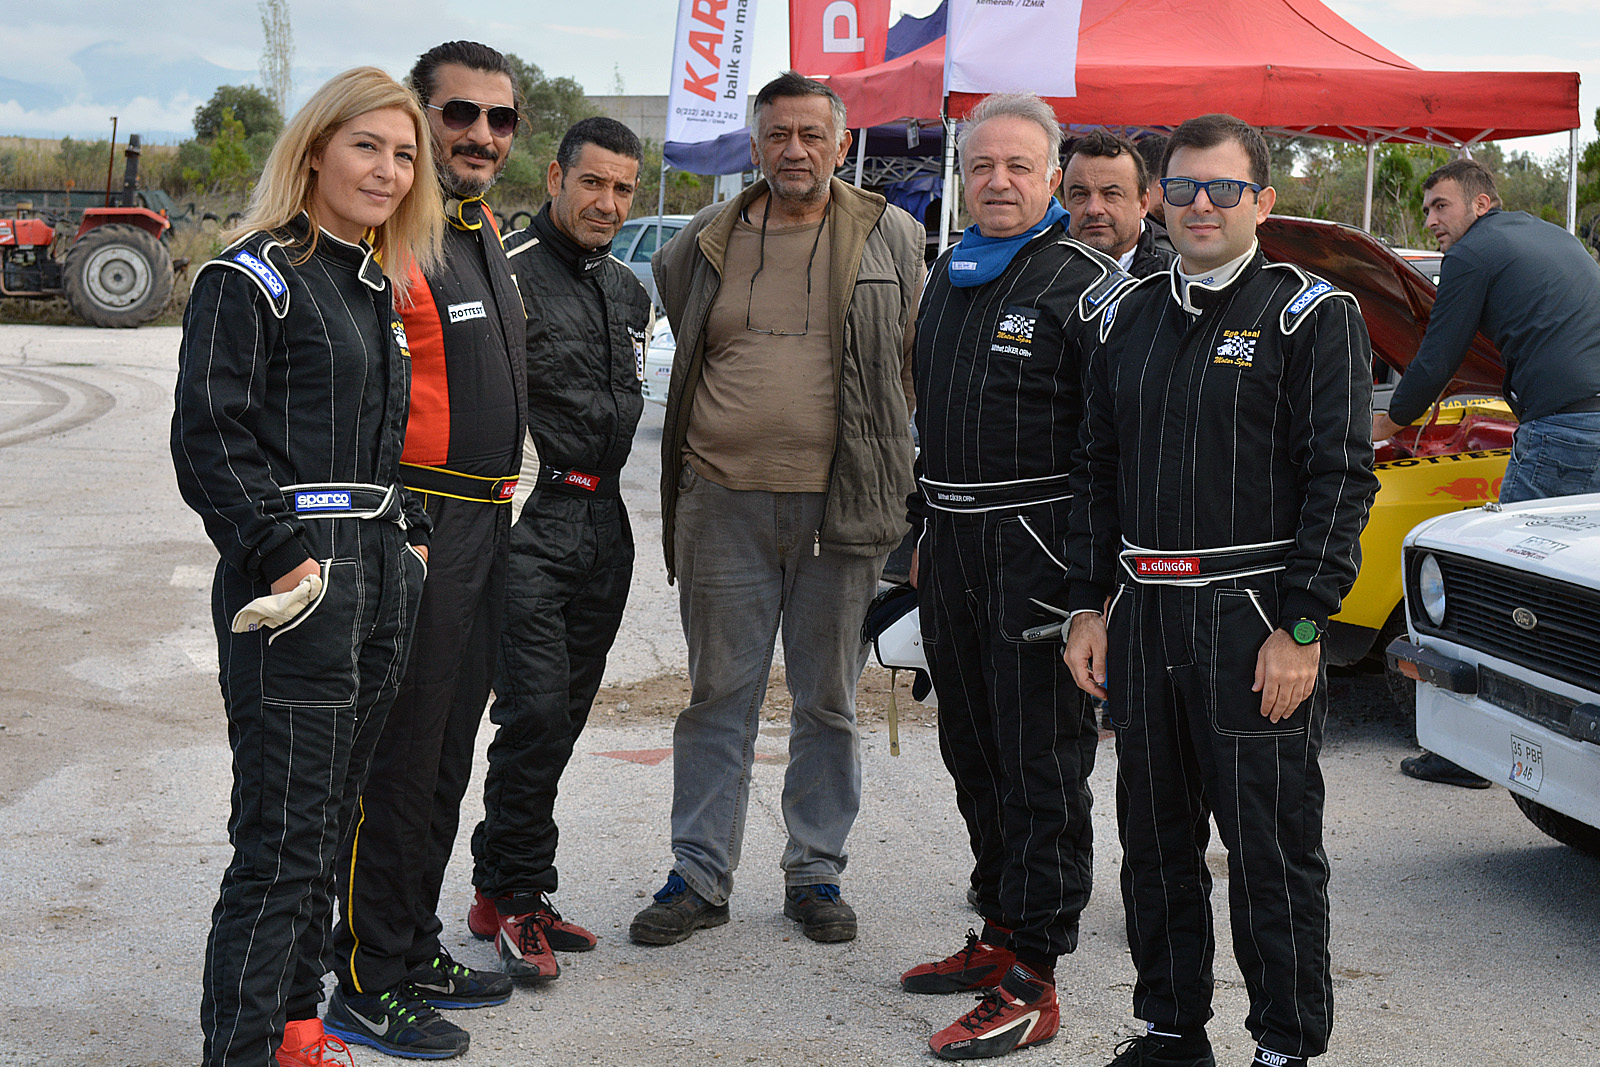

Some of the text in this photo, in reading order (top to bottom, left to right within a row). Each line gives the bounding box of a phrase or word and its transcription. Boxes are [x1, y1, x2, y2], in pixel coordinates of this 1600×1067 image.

[822, 0, 865, 53] P
[237, 253, 283, 296] sparco
[1290, 283, 1331, 313] sparco
[451, 307, 483, 319] ROTTEST
[1234, 357, 1253, 367] Spor
[1372, 449, 1512, 471] ROTTES
[297, 493, 350, 508] sparco
[1141, 560, 1193, 572] B.GÜNGÖR
[1512, 741, 1522, 757] 35
[1522, 765, 1533, 781] 46
[1262, 1053, 1287, 1066] OMP
